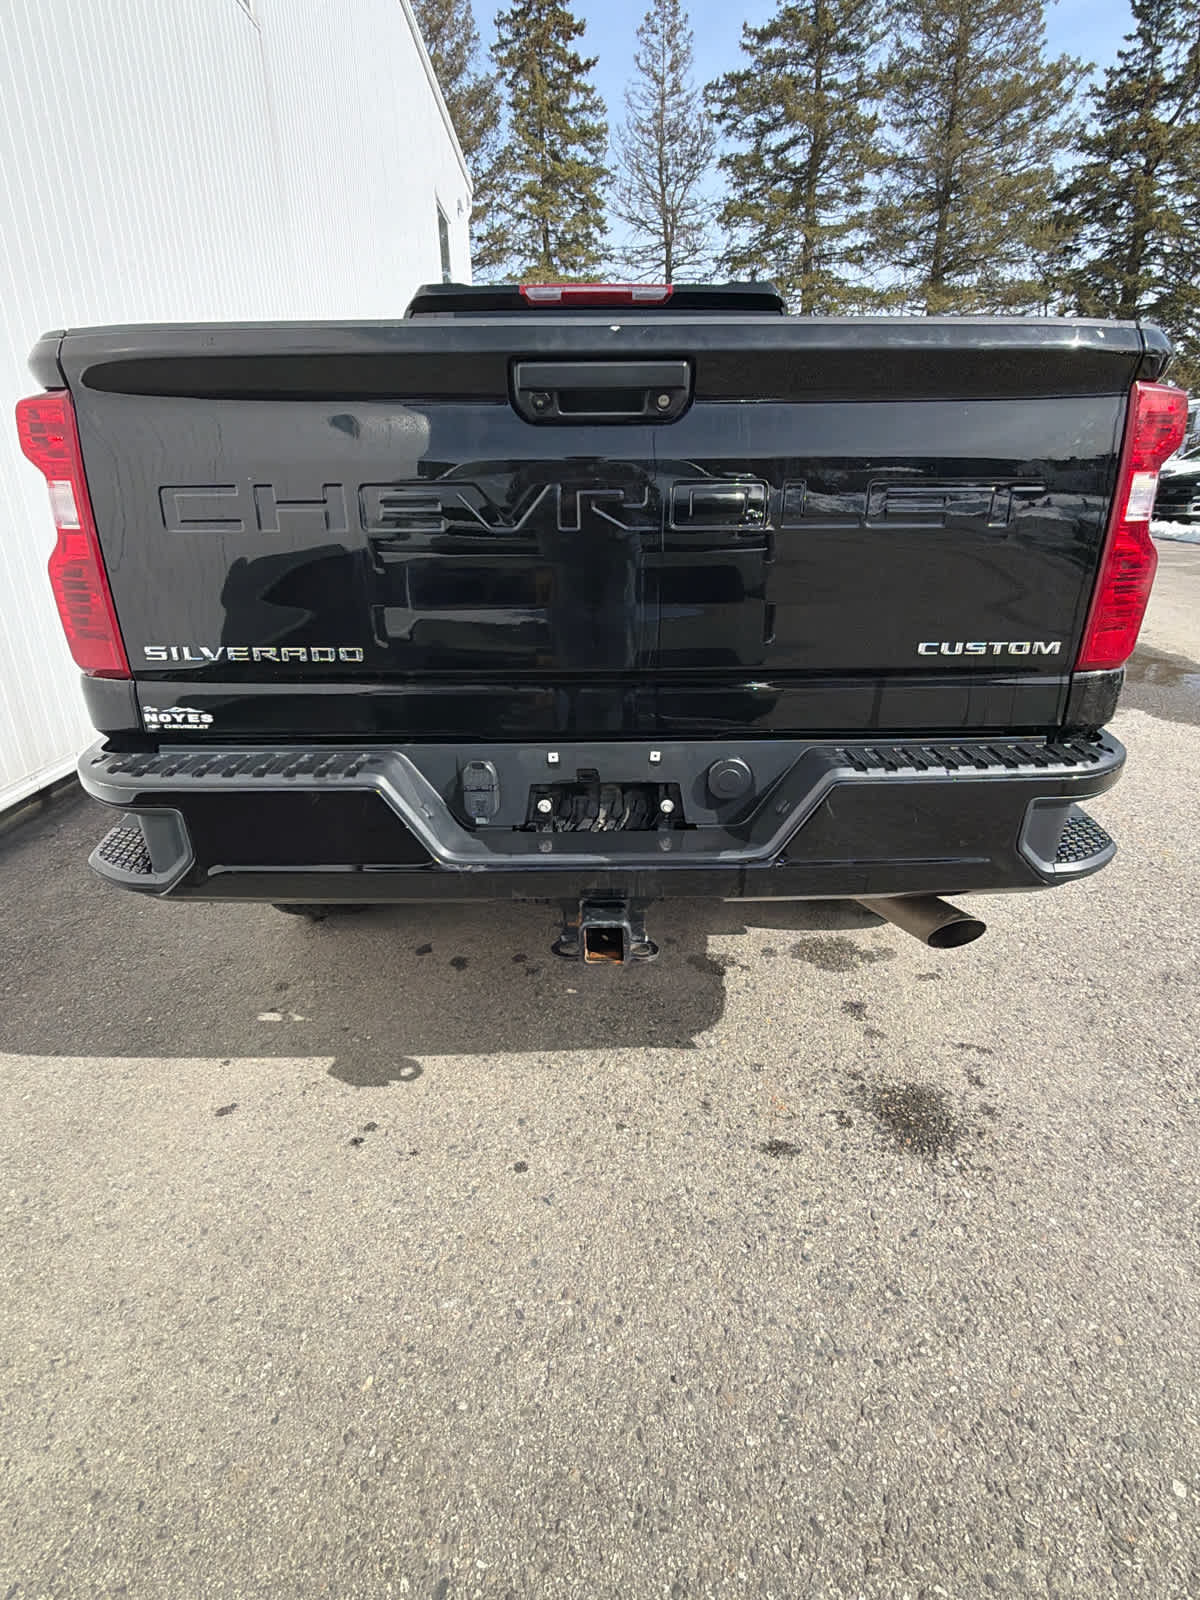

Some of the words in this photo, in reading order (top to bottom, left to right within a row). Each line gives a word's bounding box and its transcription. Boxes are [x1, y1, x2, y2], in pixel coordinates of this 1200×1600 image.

[158, 479, 1048, 534] CHEVROLET
[143, 646, 365, 662] SILVERADO
[918, 641, 1062, 655] CUSTOM
[143, 713, 214, 723] NOYES
